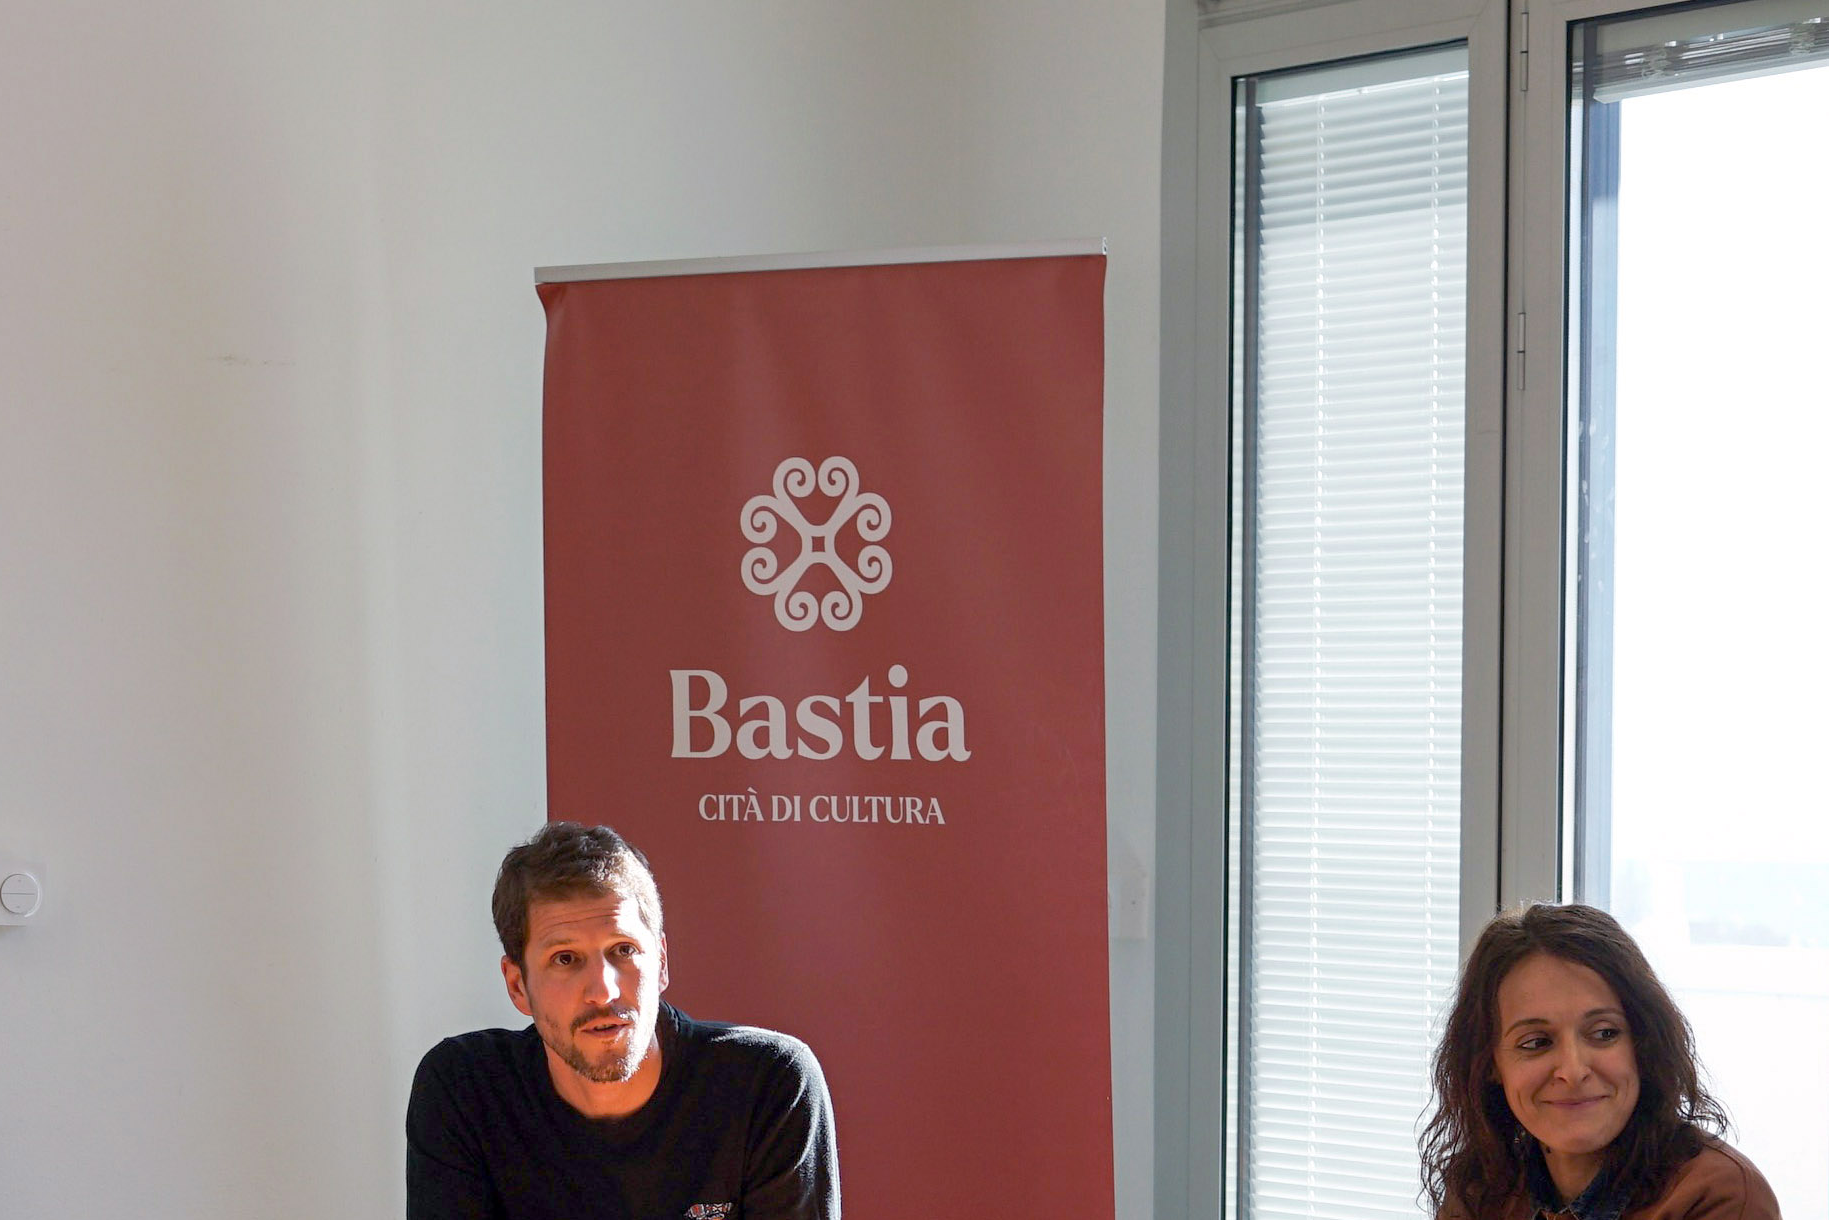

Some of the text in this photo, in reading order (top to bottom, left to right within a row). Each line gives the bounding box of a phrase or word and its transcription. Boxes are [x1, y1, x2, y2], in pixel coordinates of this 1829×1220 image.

[669, 664, 972, 762] Bastia
[698, 786, 946, 825] CITÀ DI CULTURA
